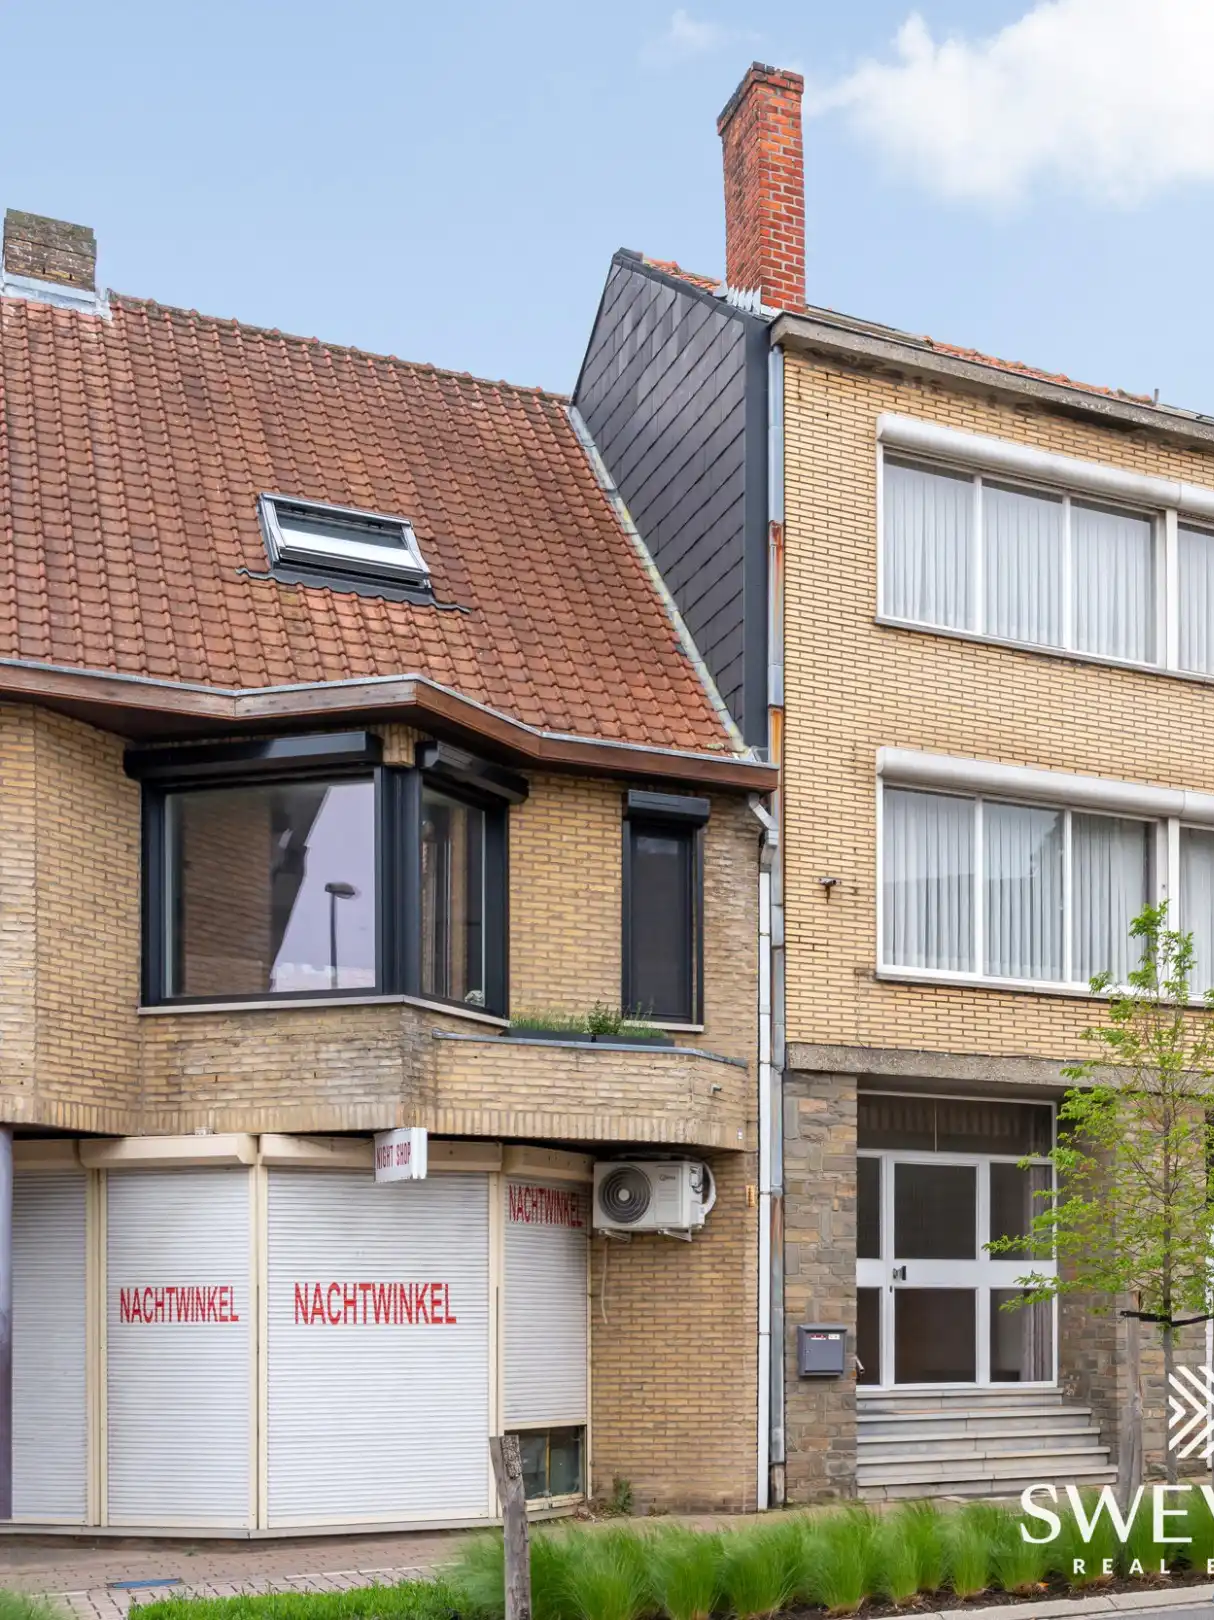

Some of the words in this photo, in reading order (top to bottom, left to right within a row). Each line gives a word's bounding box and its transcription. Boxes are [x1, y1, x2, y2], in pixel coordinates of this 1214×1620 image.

[376, 1145, 394, 1170] NIGHT
[396, 1141, 412, 1166] SHOP
[508, 1183, 582, 1228] NACHTWINKEL
[120, 1286, 239, 1323] NACHTWINKEL
[294, 1282, 457, 1325] NACHTWINKEL
